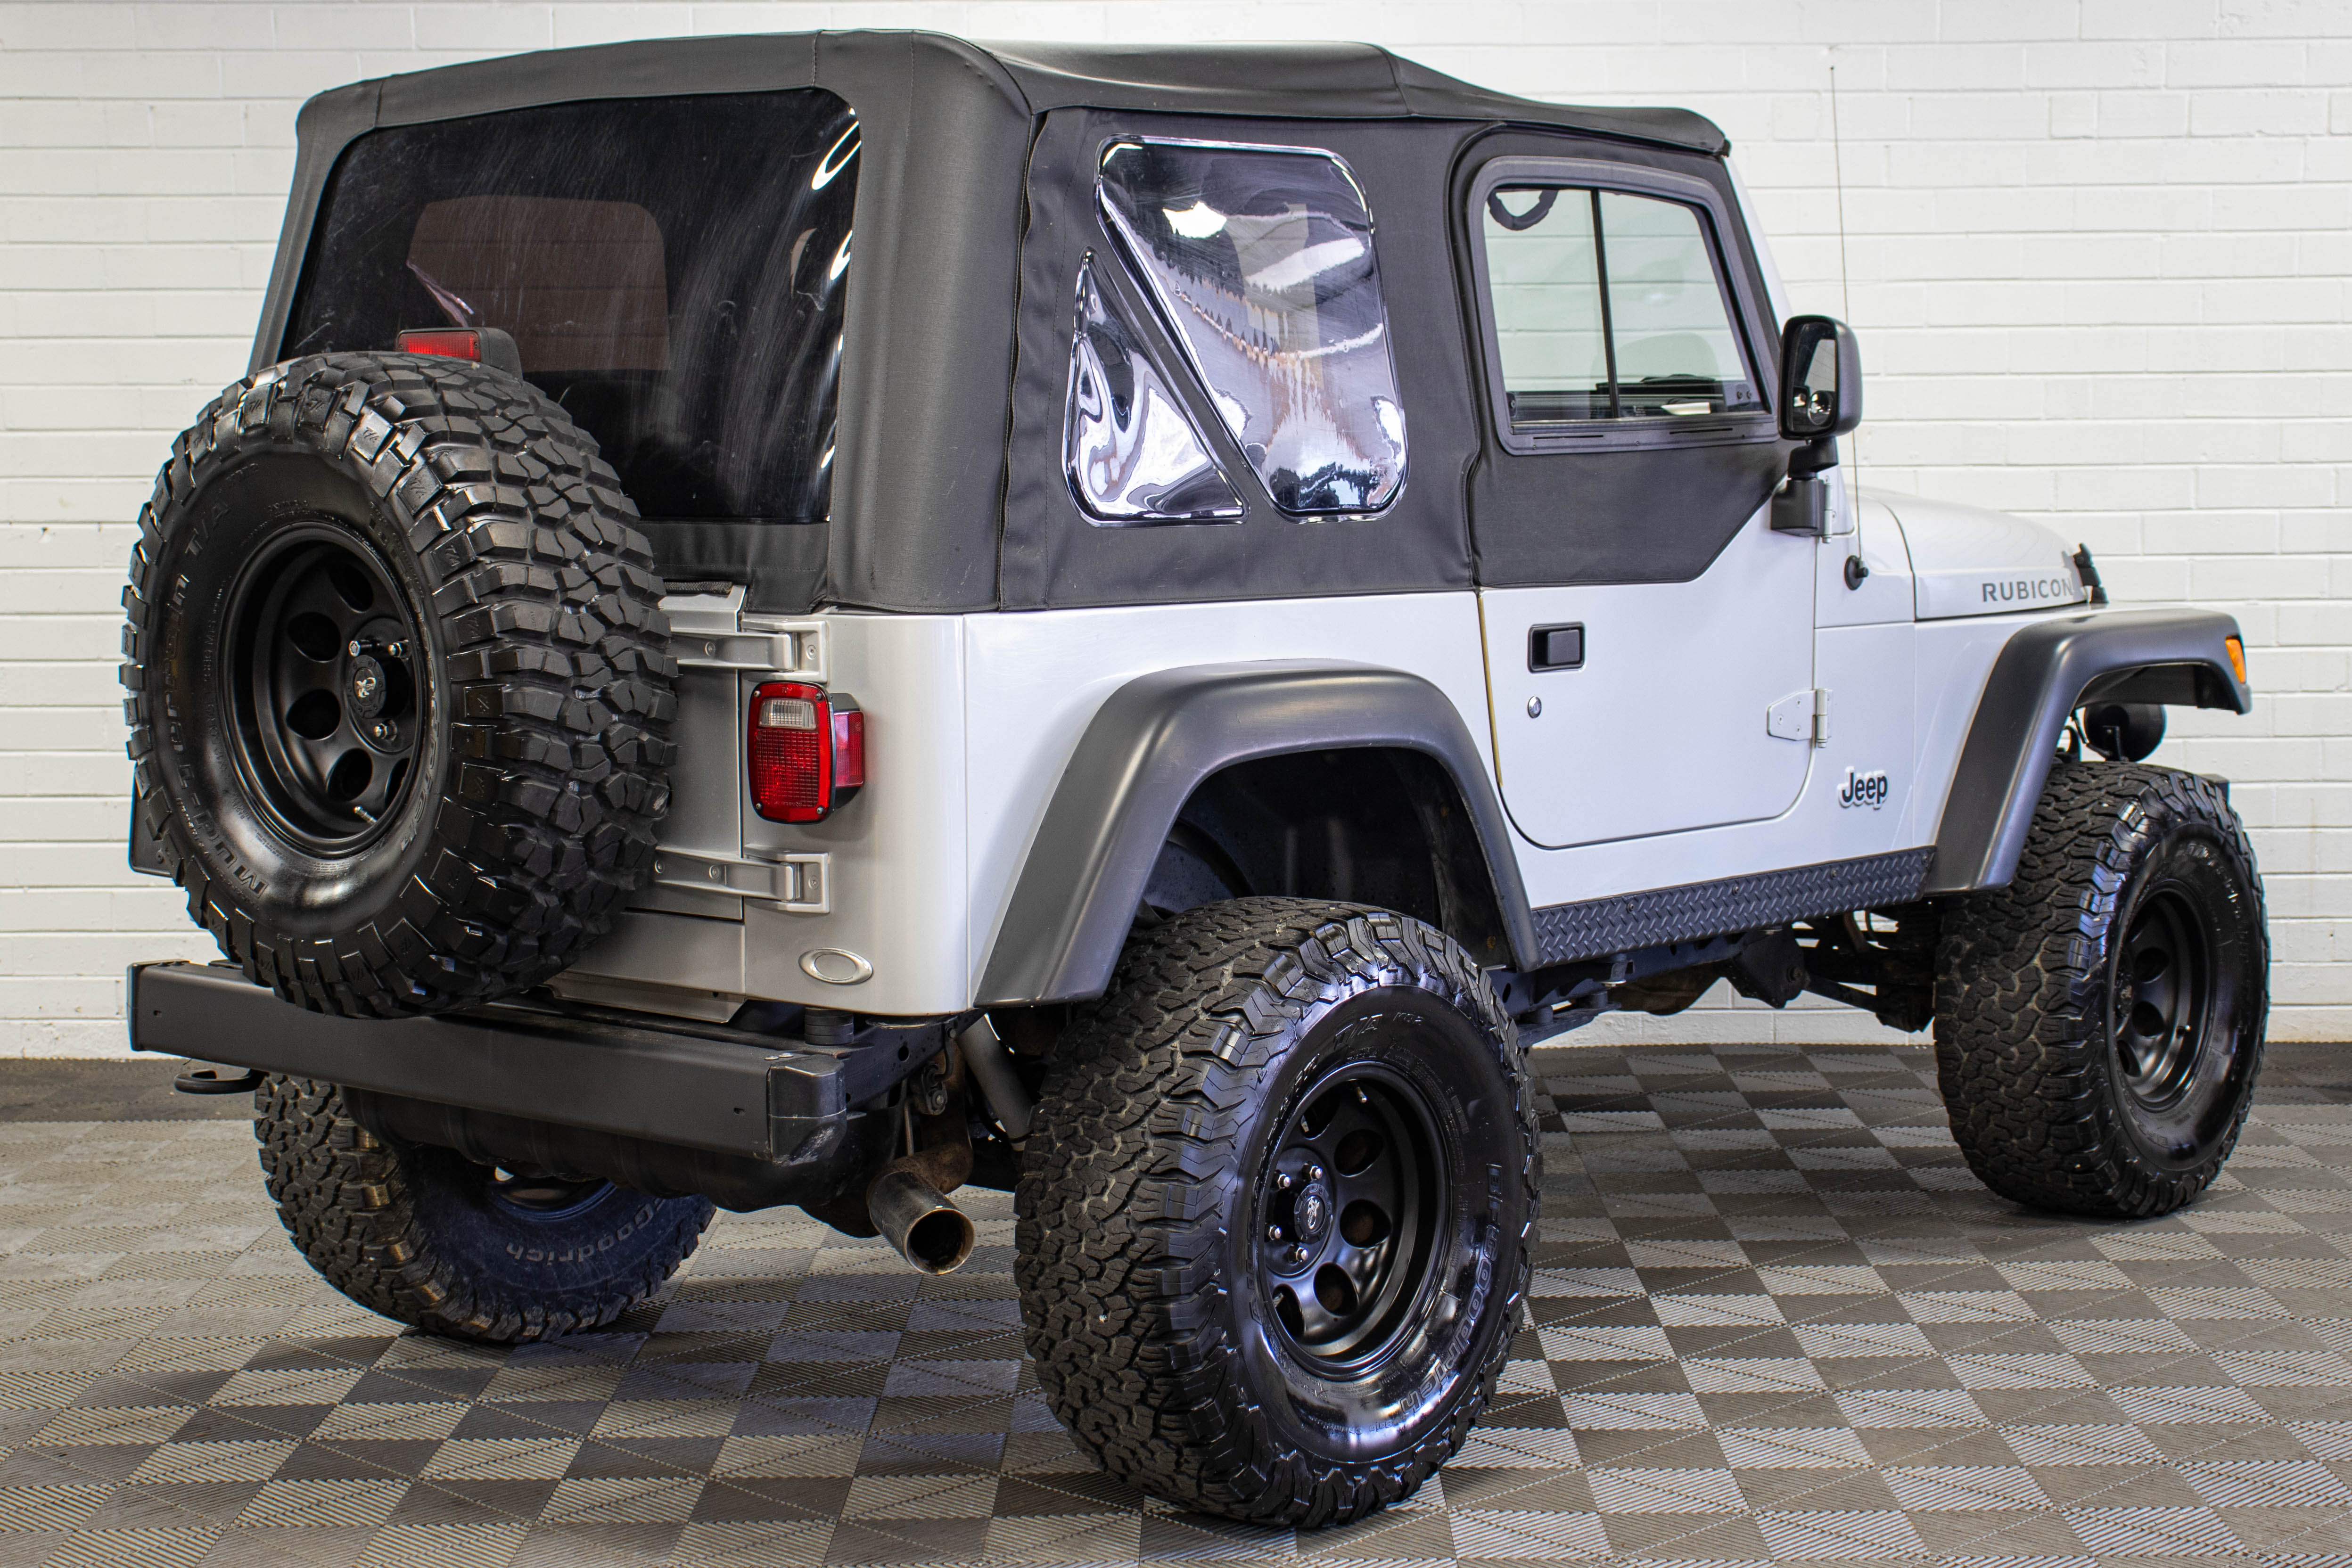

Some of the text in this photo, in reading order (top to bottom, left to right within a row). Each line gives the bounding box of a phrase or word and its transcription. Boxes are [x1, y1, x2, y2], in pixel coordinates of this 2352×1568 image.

[1982, 578, 2074, 602] RUBICON
[1842, 772, 1888, 804] Jeep
[1399, 1163, 1503, 1413] BFGoodrich
